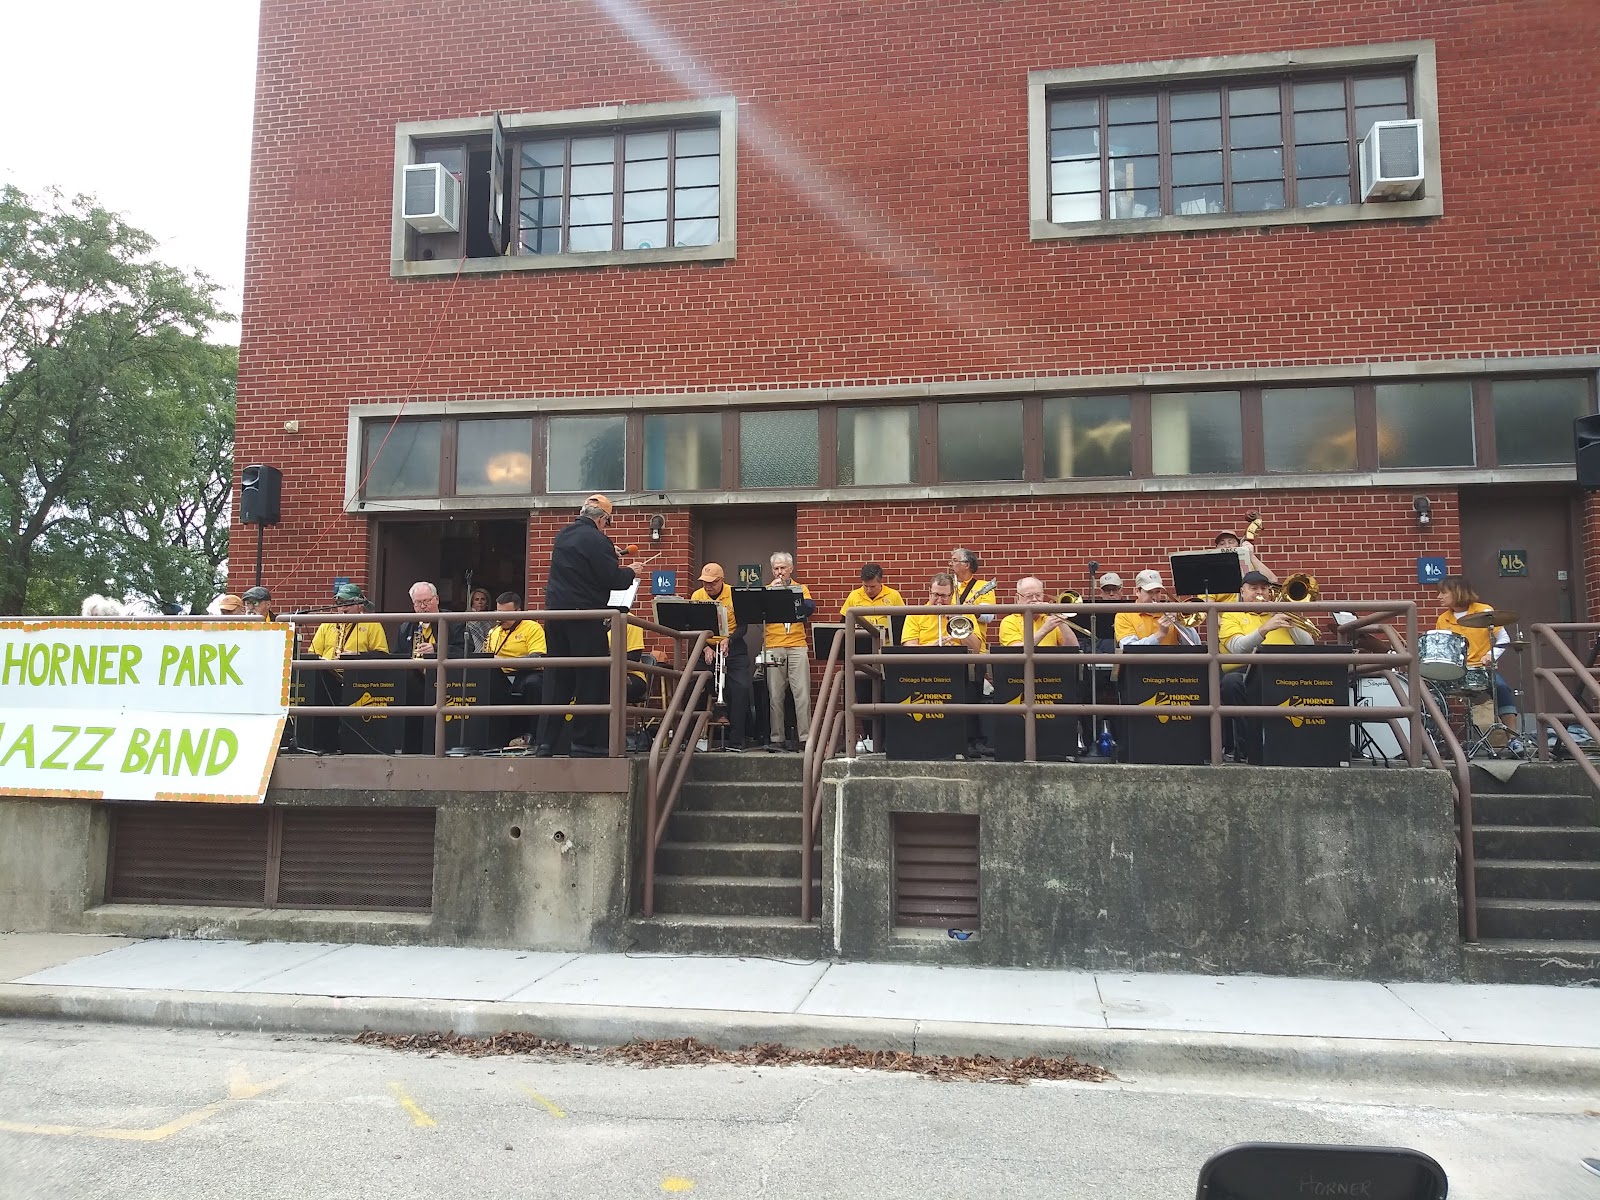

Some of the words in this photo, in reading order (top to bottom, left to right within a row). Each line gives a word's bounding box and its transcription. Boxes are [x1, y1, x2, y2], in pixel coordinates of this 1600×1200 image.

[2, 643, 142, 686] HORNER
[158, 643, 244, 686] PARK
[0, 722, 117, 771] AZZ
[120, 727, 239, 777] BAND
[1299, 1171, 1372, 1196] HORNER
